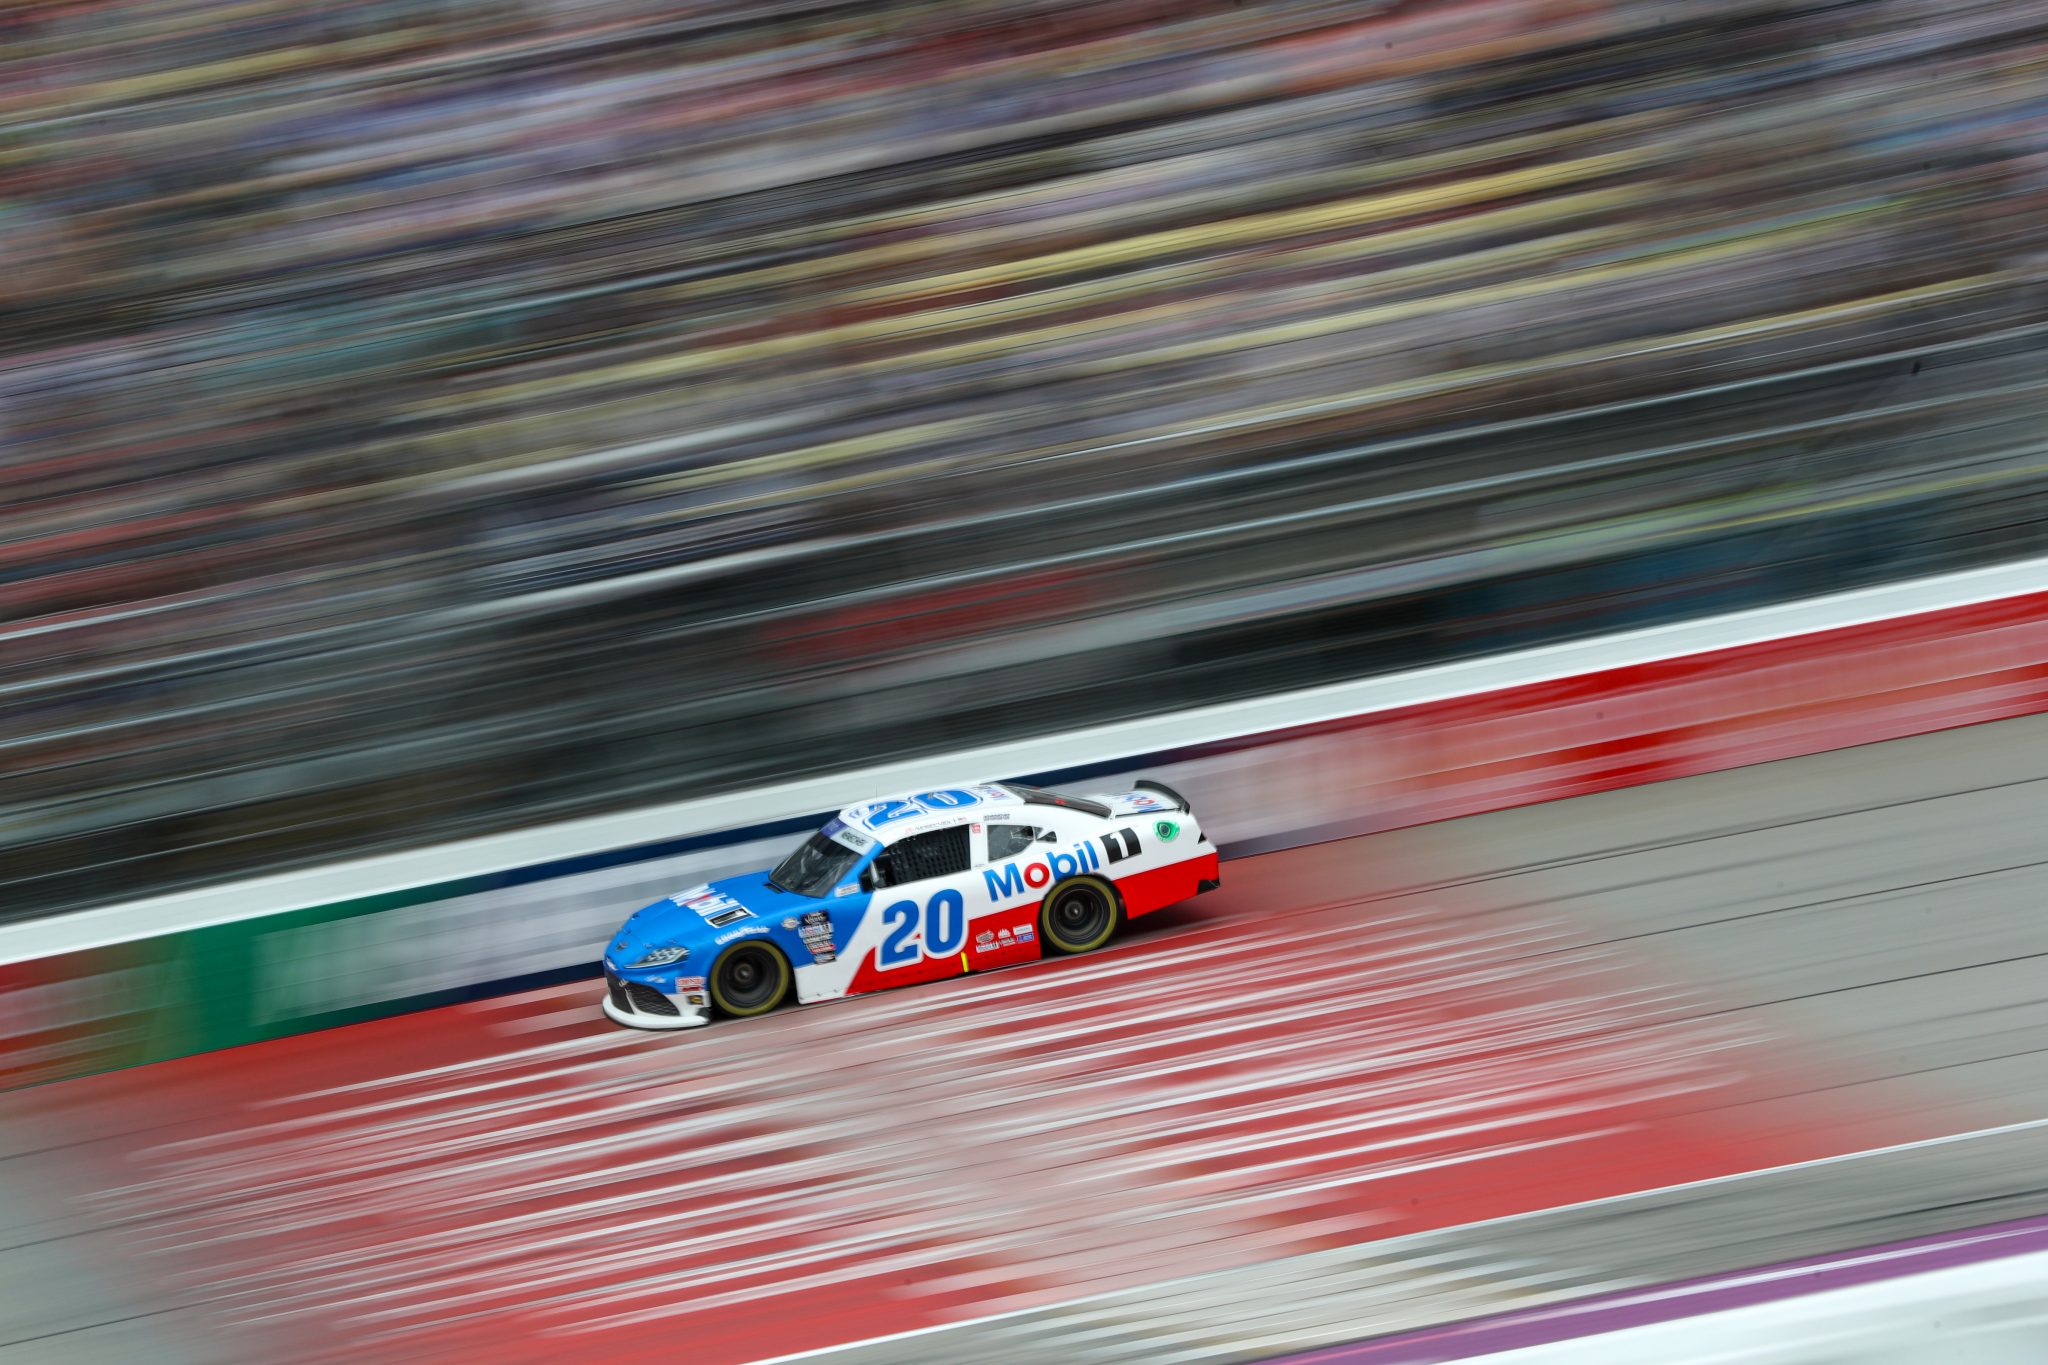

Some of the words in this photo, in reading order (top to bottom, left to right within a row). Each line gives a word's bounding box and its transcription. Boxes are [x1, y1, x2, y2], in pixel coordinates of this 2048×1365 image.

[863, 788, 983, 832] 20
[983, 840, 1100, 902] Mobil
[880, 888, 964, 966] 20
